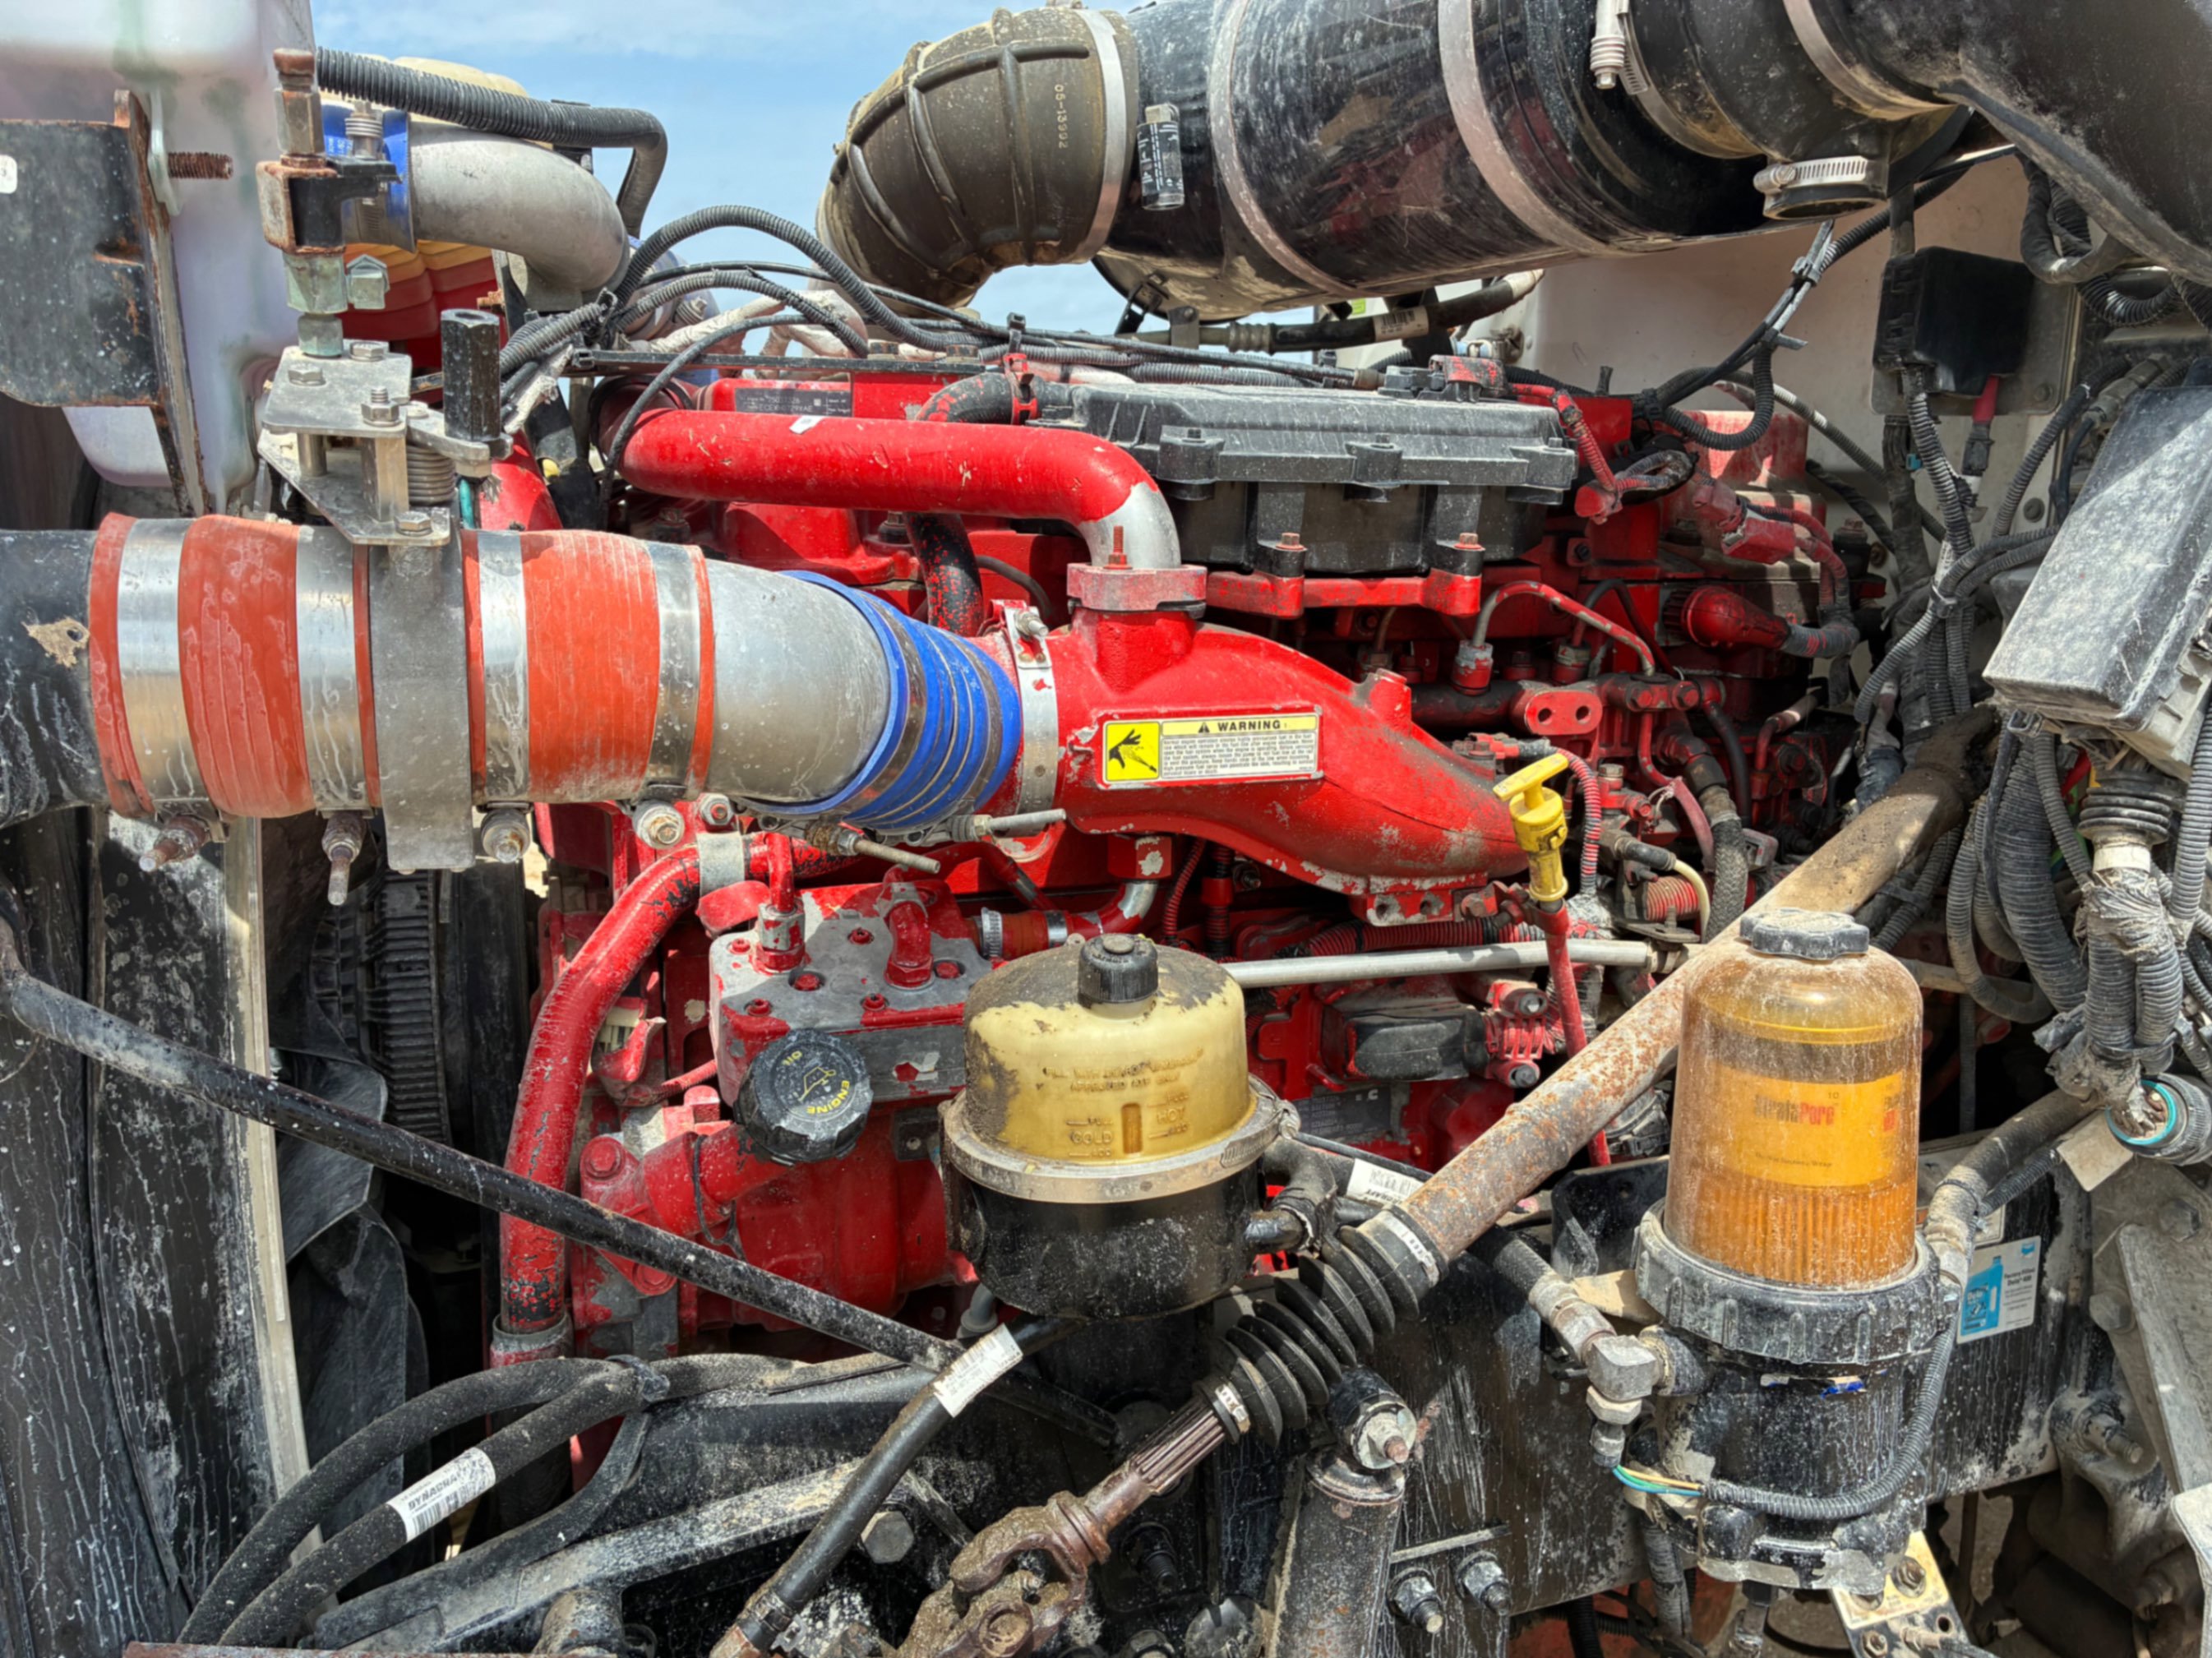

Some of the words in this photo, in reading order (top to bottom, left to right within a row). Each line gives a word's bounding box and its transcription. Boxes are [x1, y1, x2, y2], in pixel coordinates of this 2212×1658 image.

[1217, 720, 1281, 732] WARNING
[782, 1051, 802, 1066] OIL
[806, 1080, 850, 1115] ENGINE
[1157, 1106, 1185, 1124] HOT
[1070, 1130, 1113, 1145] COLD
